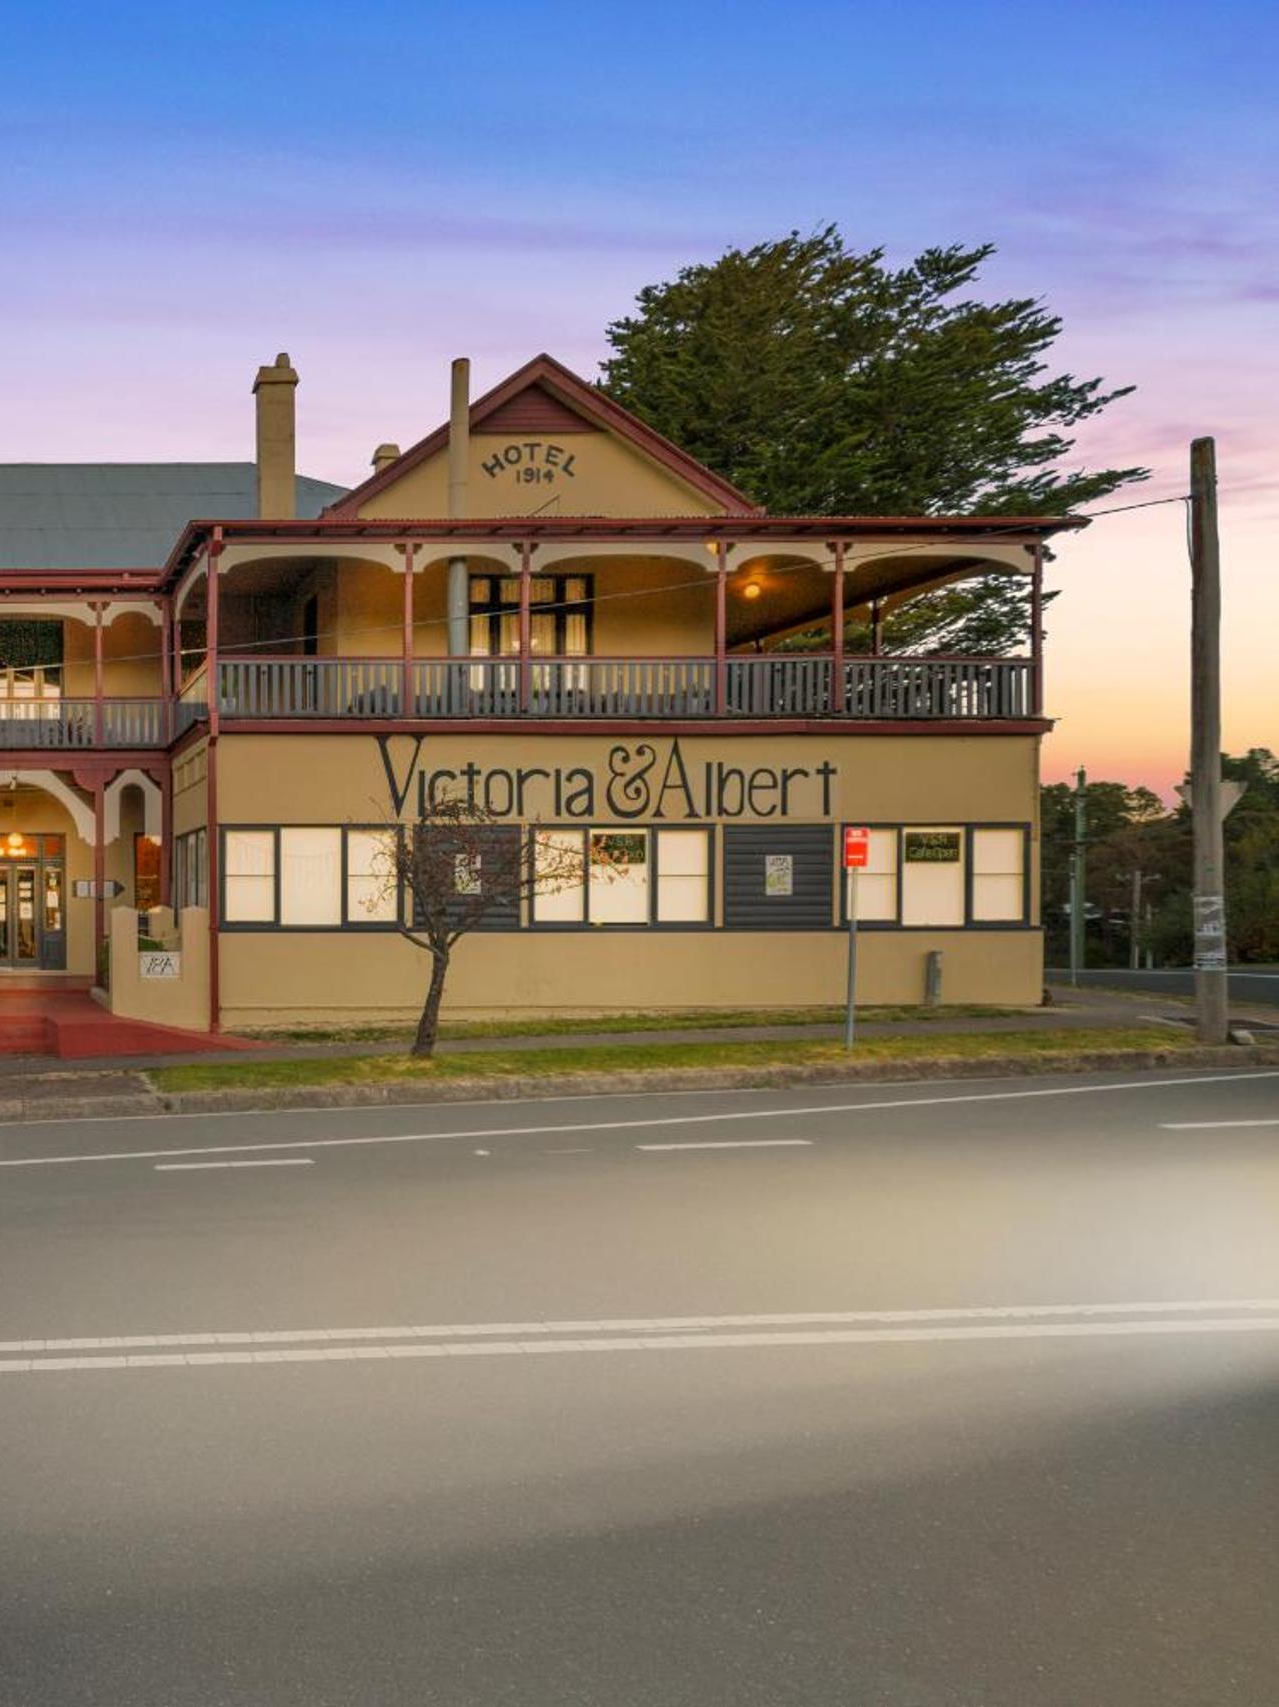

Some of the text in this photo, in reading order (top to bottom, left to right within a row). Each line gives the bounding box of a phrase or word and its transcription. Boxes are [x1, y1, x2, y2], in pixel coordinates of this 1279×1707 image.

[481, 442, 576, 478] HOTEL
[516, 467, 555, 483] 1914
[376, 735, 837, 818] Victoria & Albert
